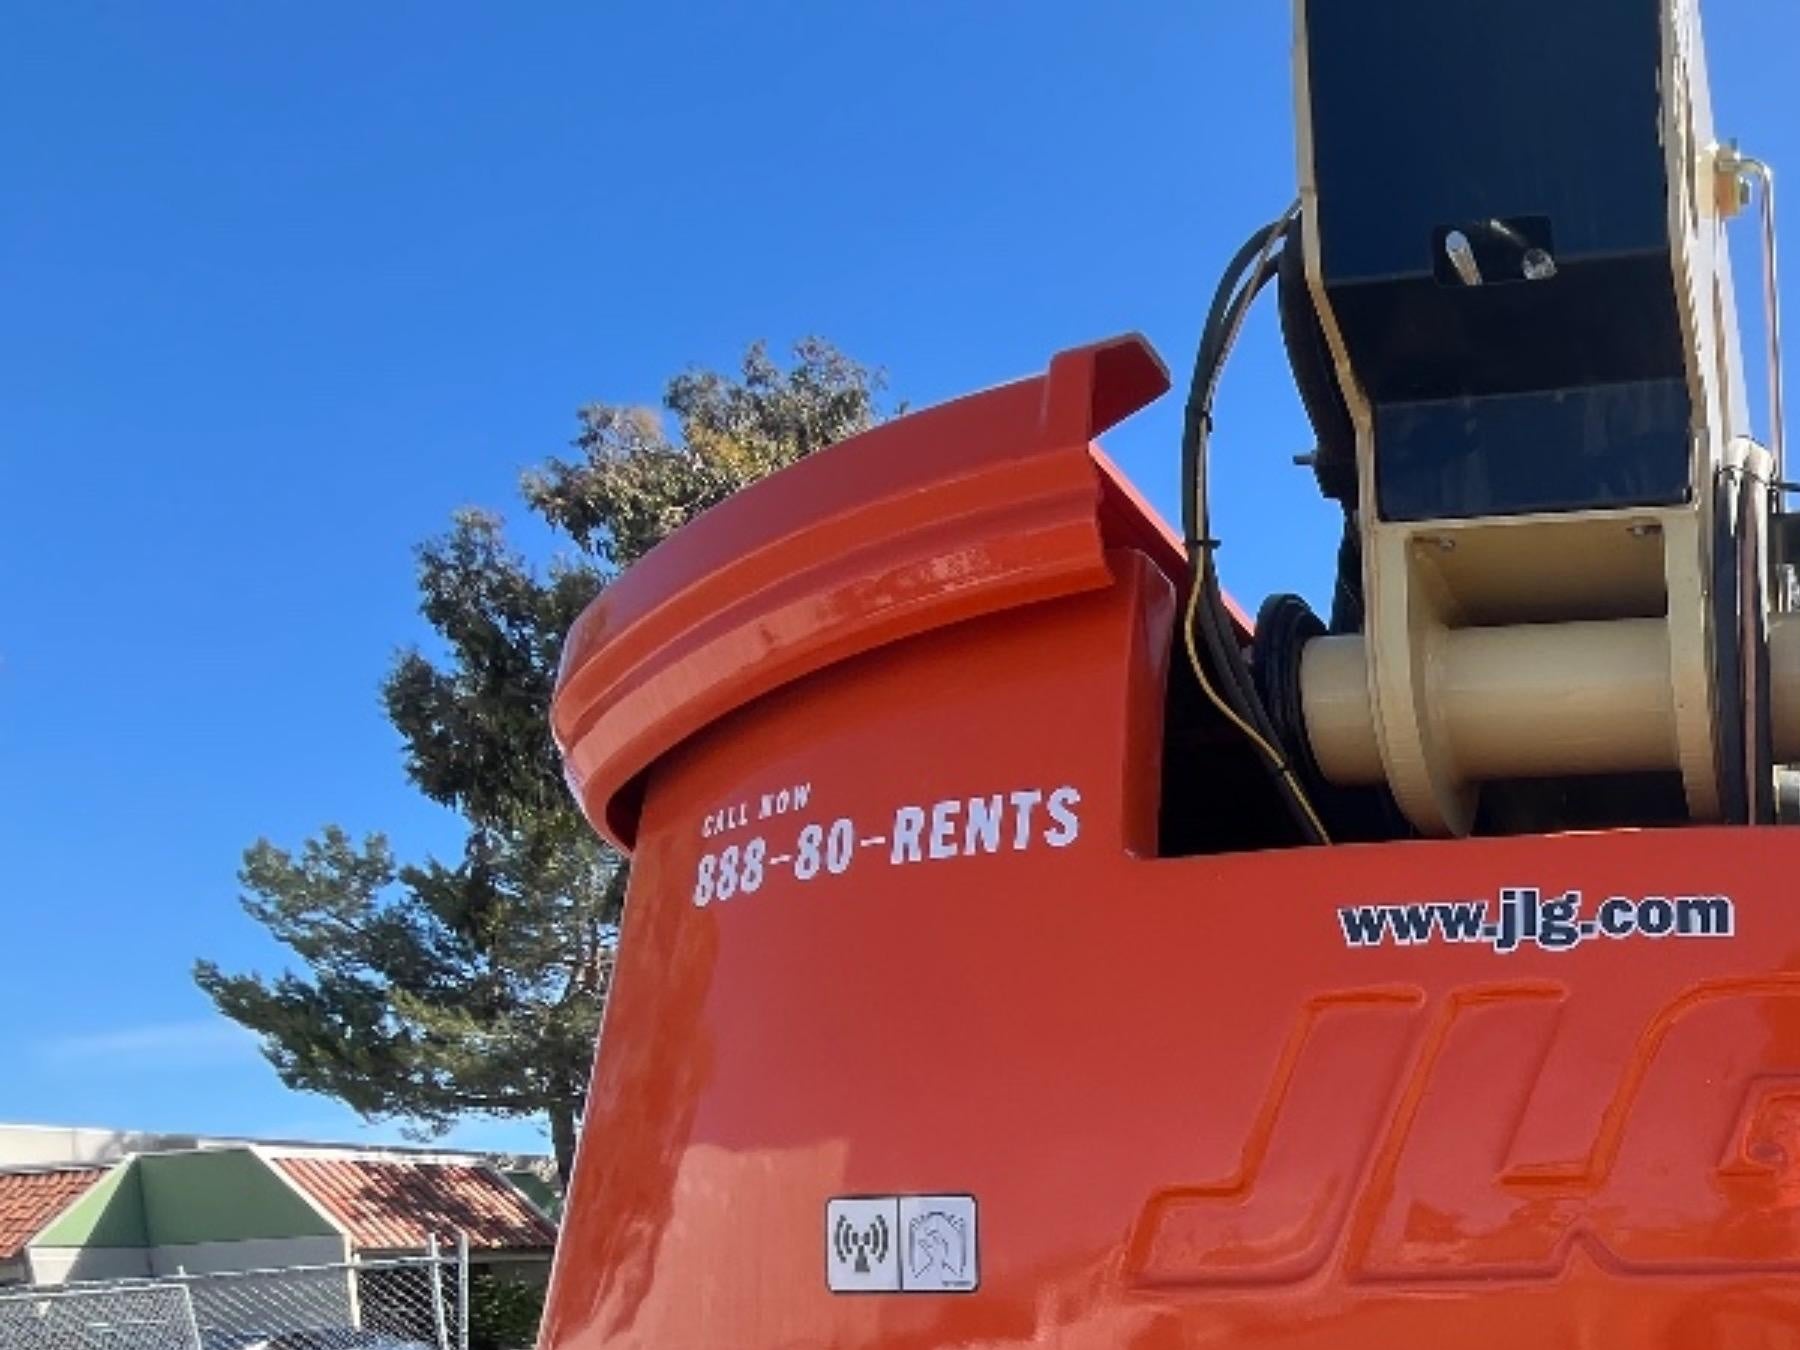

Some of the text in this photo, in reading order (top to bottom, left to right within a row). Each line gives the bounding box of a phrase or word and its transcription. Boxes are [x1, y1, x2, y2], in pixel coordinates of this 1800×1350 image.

[702, 783, 812, 838] CALL NOW
[692, 786, 1081, 908] 888-80-RENTS
[1338, 888, 1736, 950] www.jlg.com
